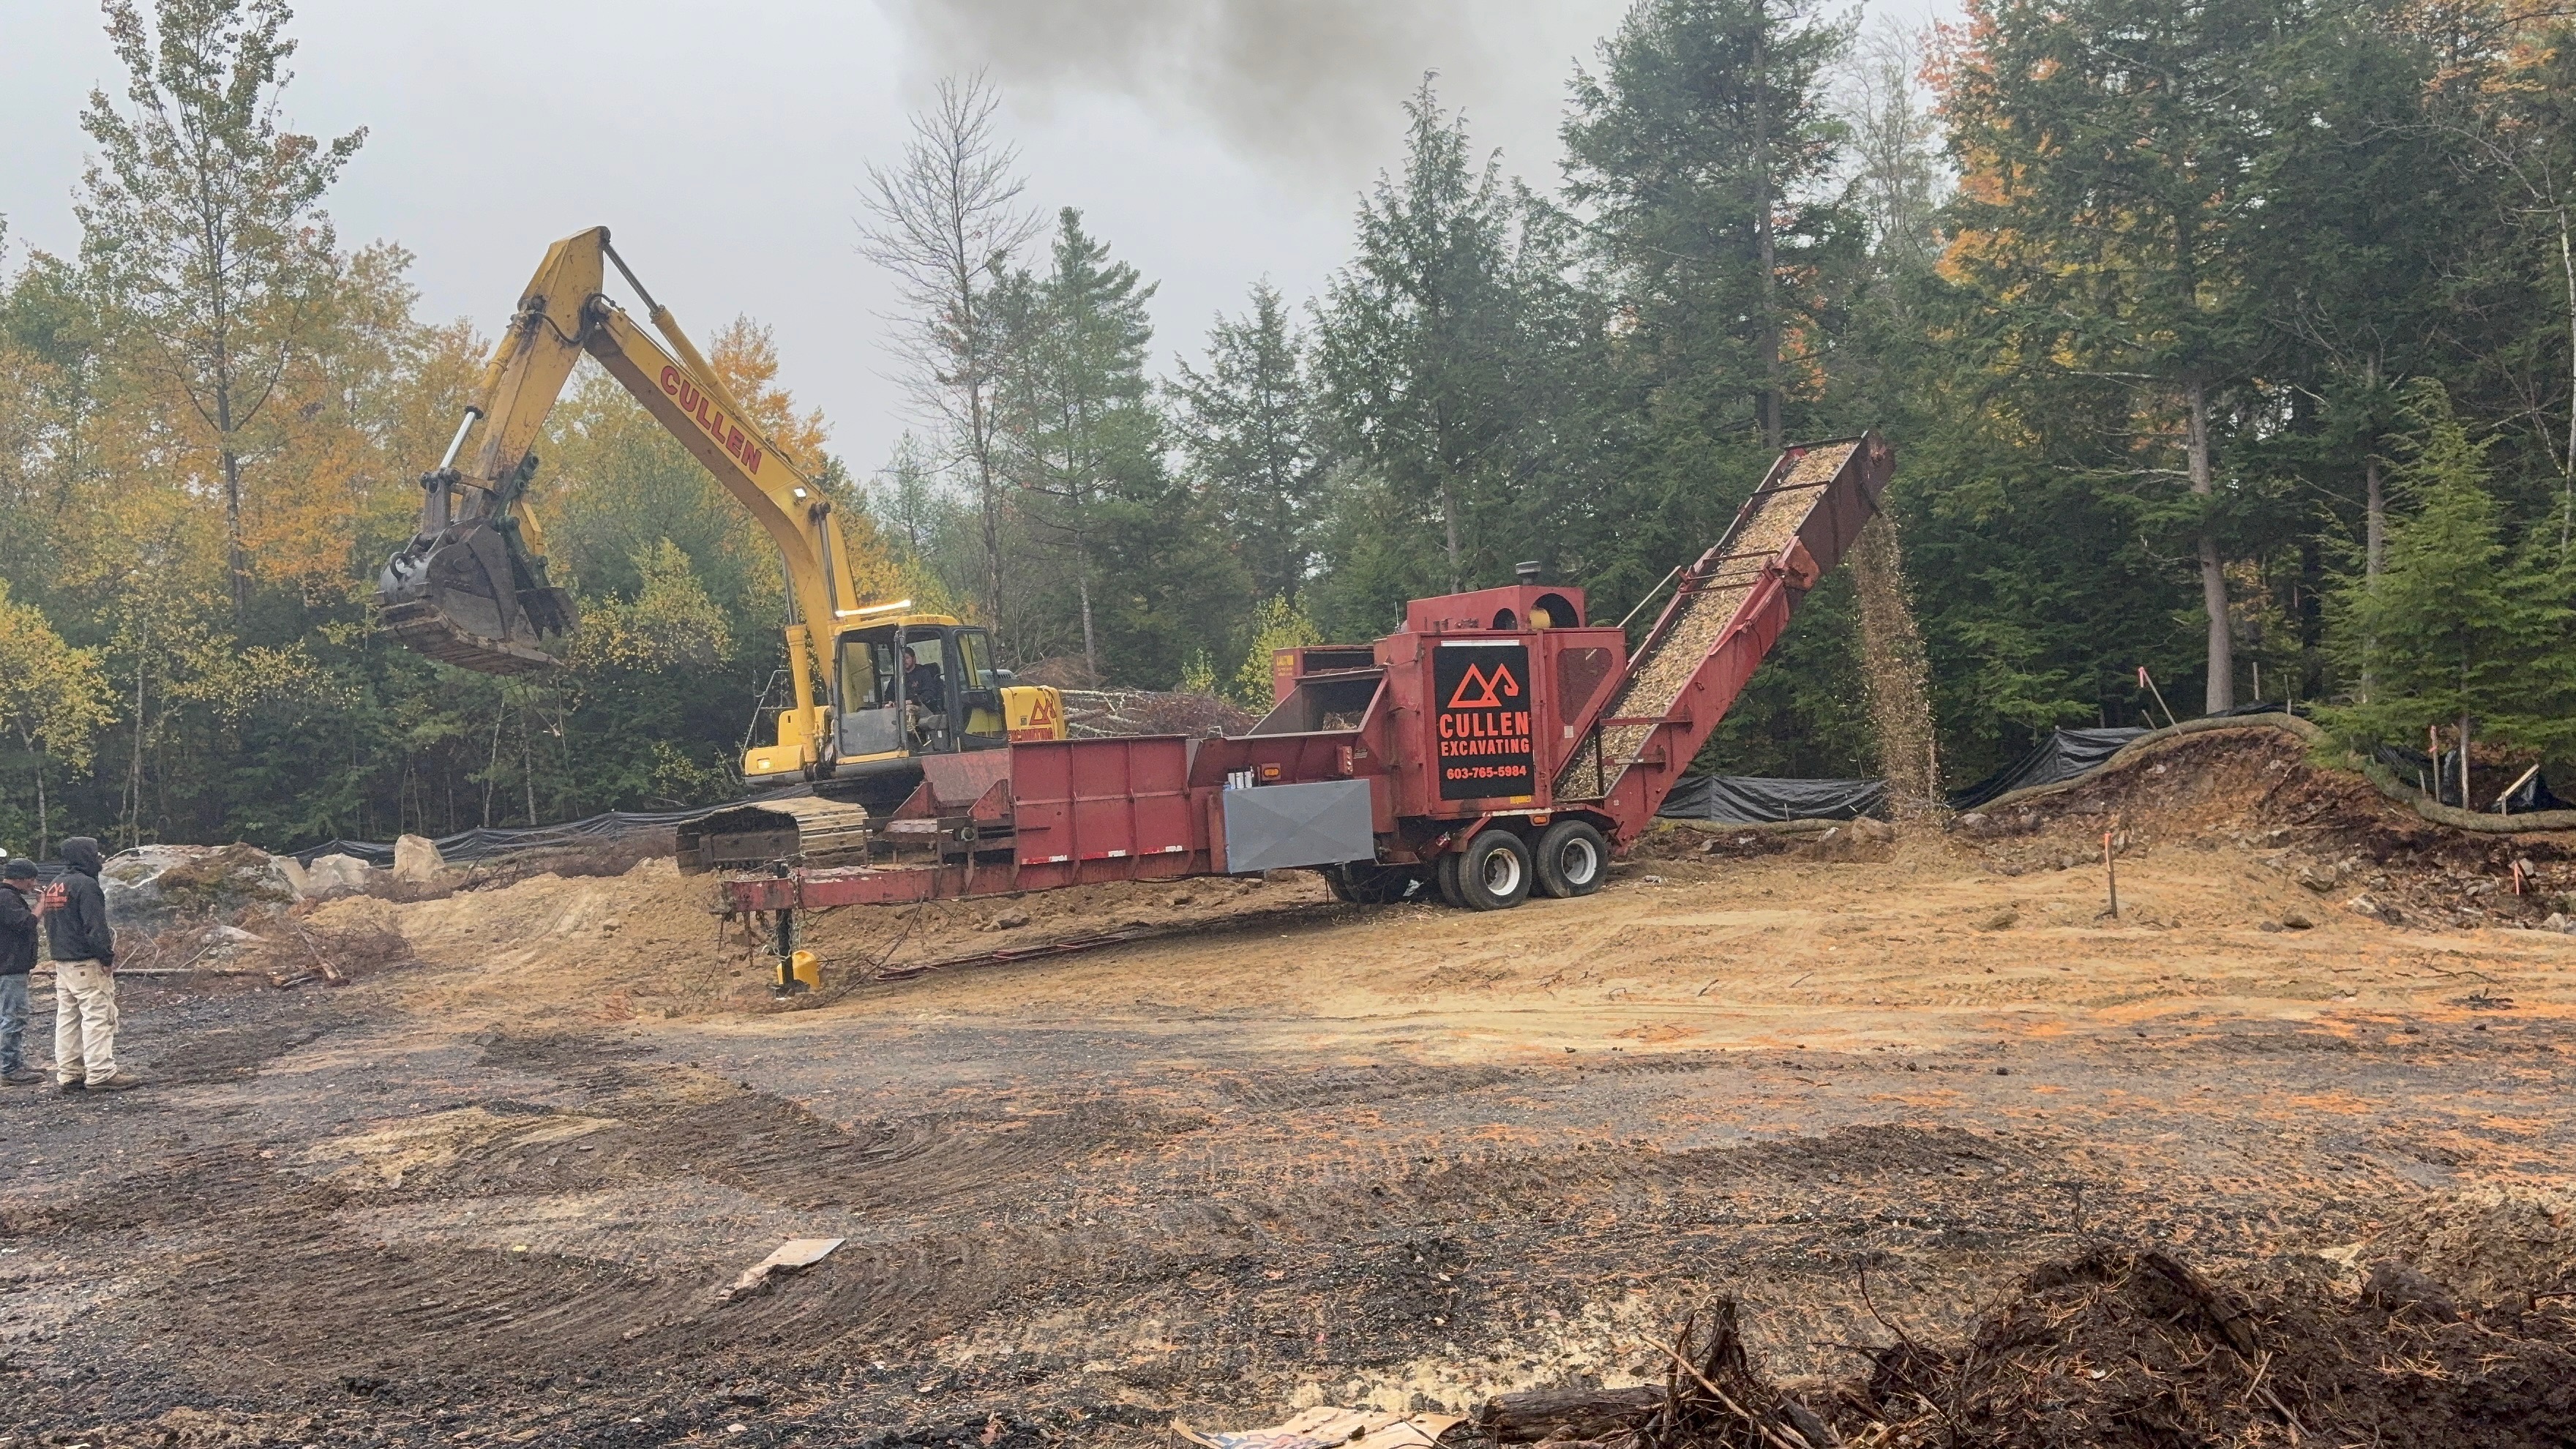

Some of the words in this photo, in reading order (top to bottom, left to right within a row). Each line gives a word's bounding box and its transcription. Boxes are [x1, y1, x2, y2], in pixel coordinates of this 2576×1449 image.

[660, 365, 762, 475] CULLEN
[1439, 711, 1529, 738] CULLEN
[1440, 738, 1530, 757] EXCAVATING
[1446, 765, 1527, 779] 603-765-5984
